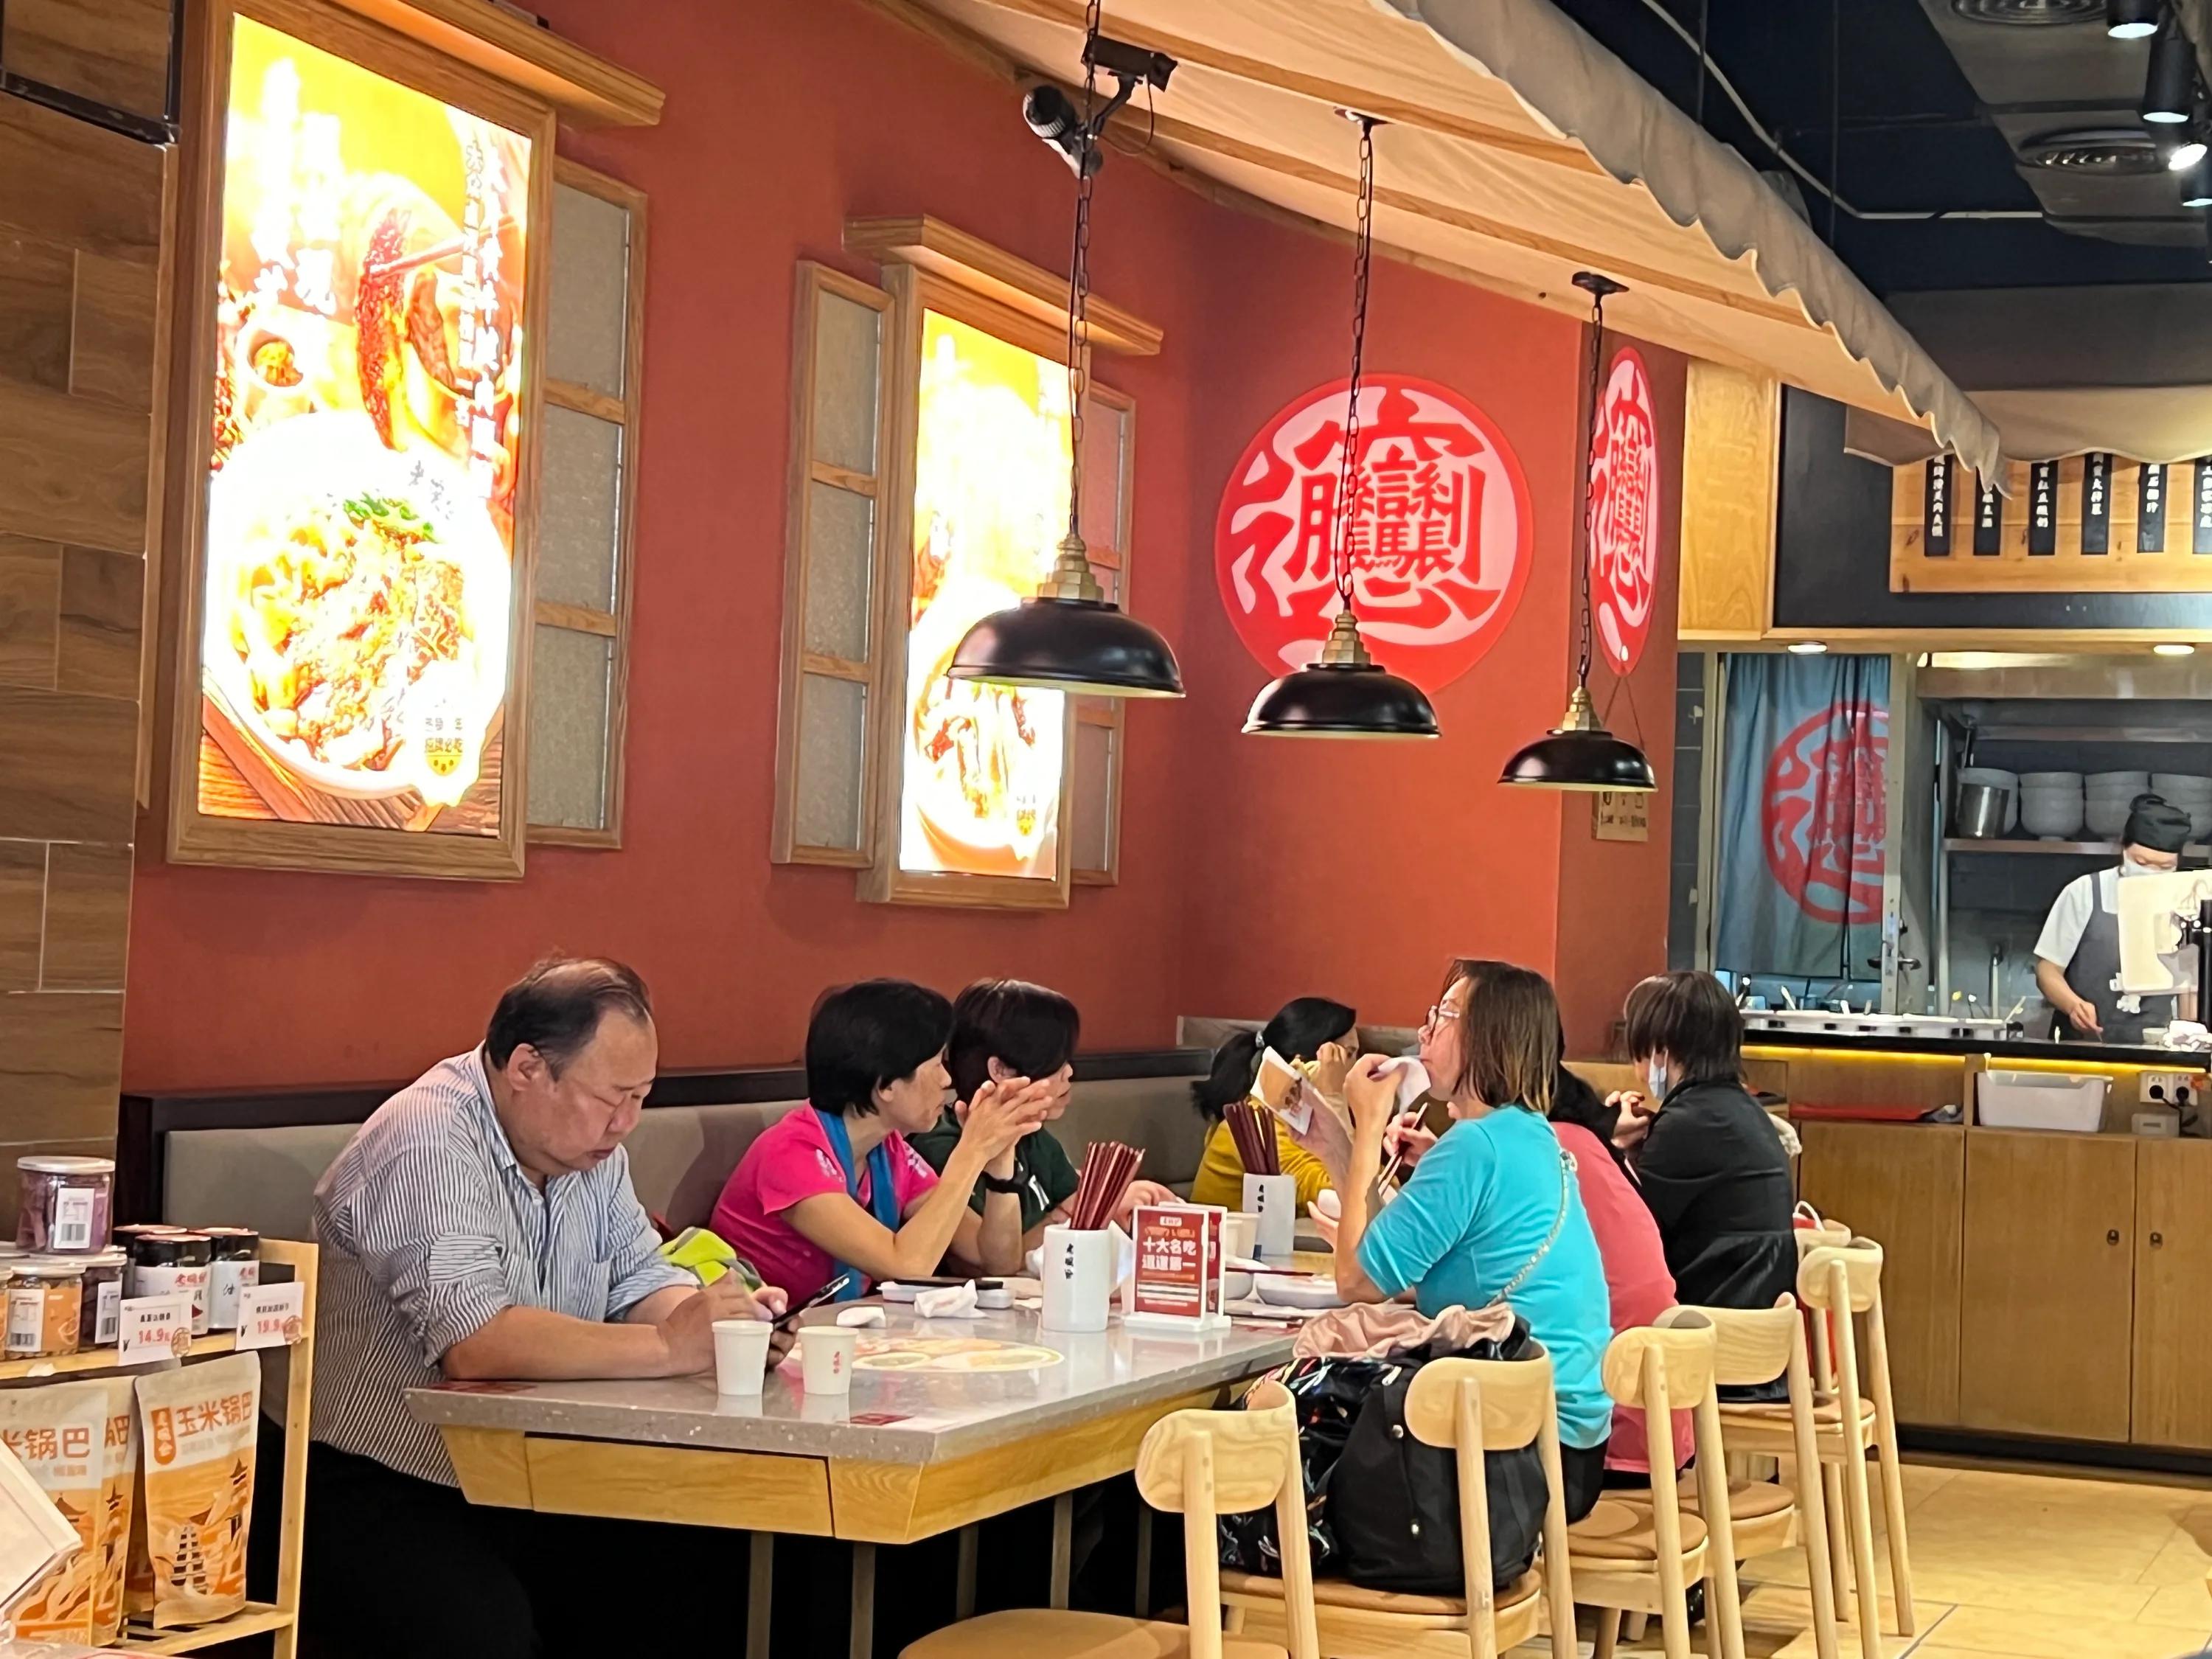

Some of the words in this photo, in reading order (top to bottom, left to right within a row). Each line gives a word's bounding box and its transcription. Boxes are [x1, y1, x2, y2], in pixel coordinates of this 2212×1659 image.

[1143, 1236, 1197, 1256] 十大名吃
[176, 1391, 254, 1438] 玉米锅巴
